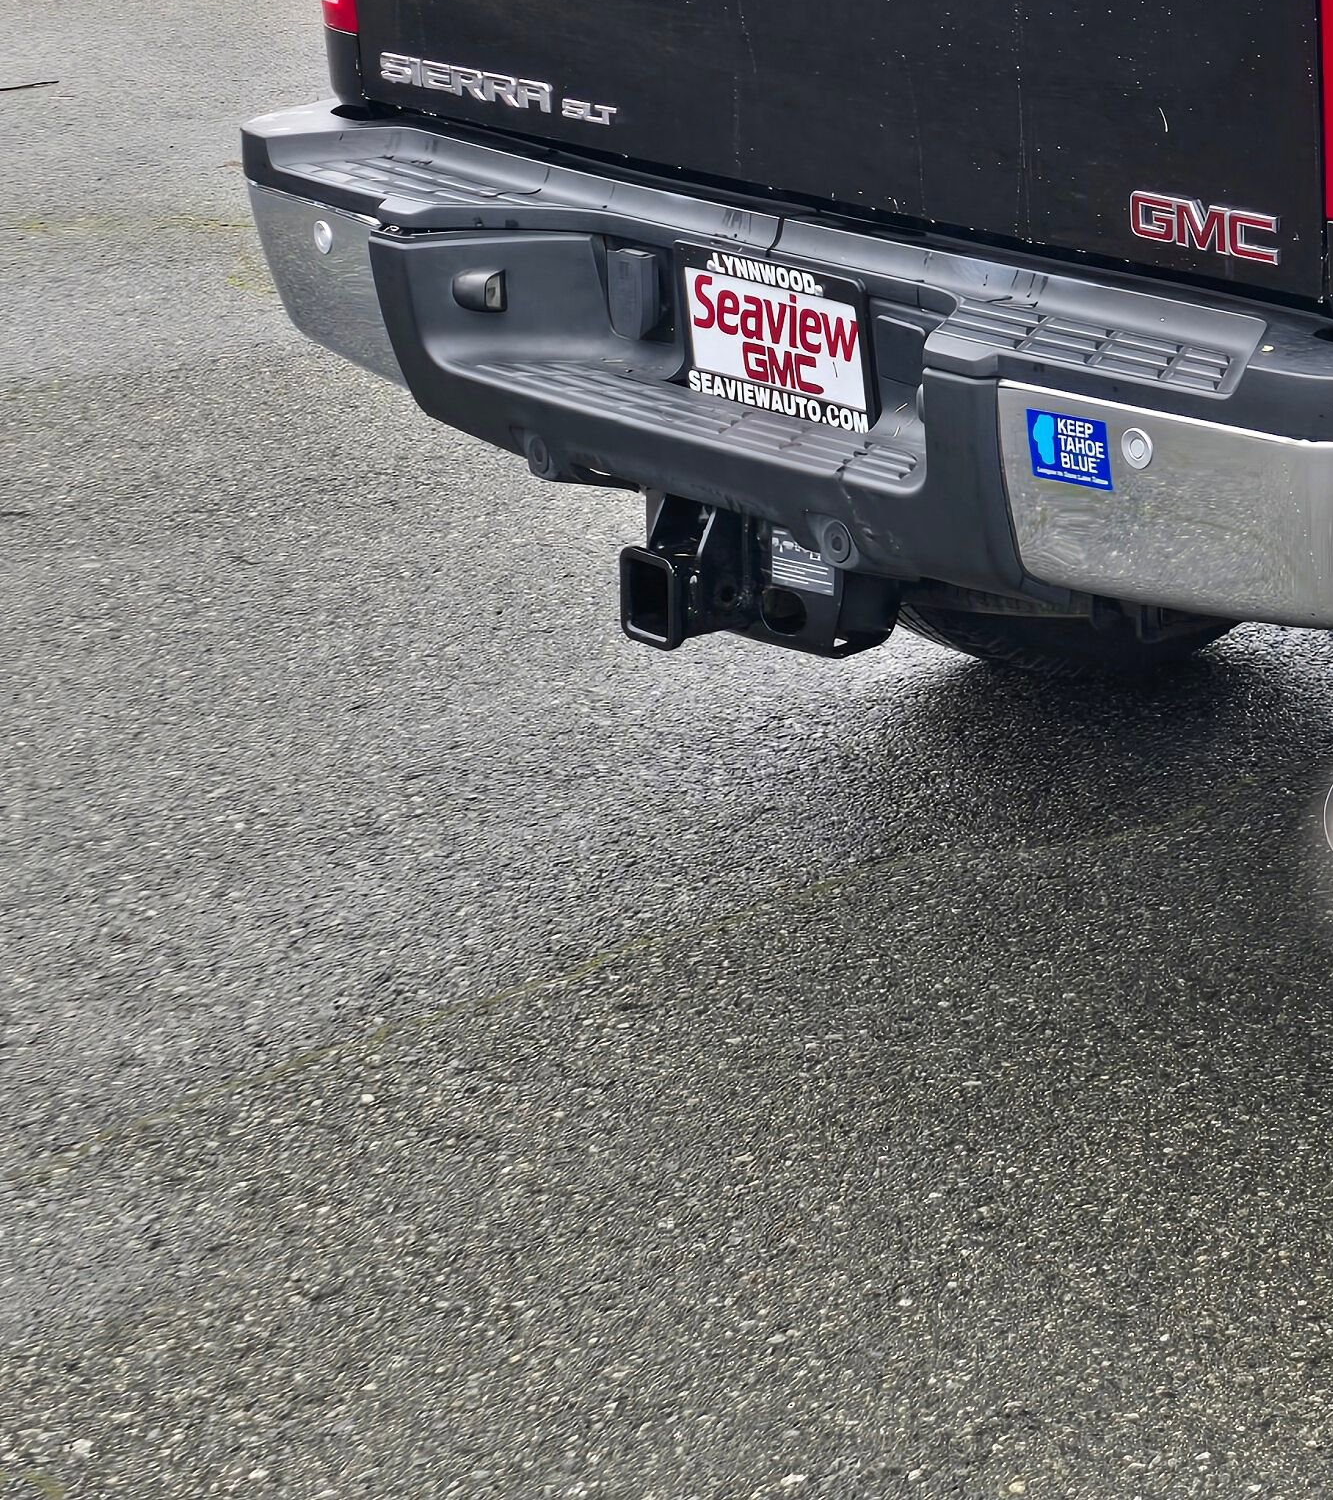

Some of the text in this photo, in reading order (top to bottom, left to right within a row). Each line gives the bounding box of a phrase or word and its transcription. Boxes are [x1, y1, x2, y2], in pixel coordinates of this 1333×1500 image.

[380, 52, 617, 125] SIERRA SLT
[1129, 190, 1280, 265] GMC
[711, 252, 816, 296] LYNNWOOD
[693, 274, 859, 363] Seaview
[742, 341, 824, 395] GMC
[688, 369, 869, 434] SEAVIEWAUTO.COM
[1057, 417, 1094, 438] KEEP
[1057, 435, 1105, 459] TAHOE
[1060, 451, 1099, 474] BLUE
